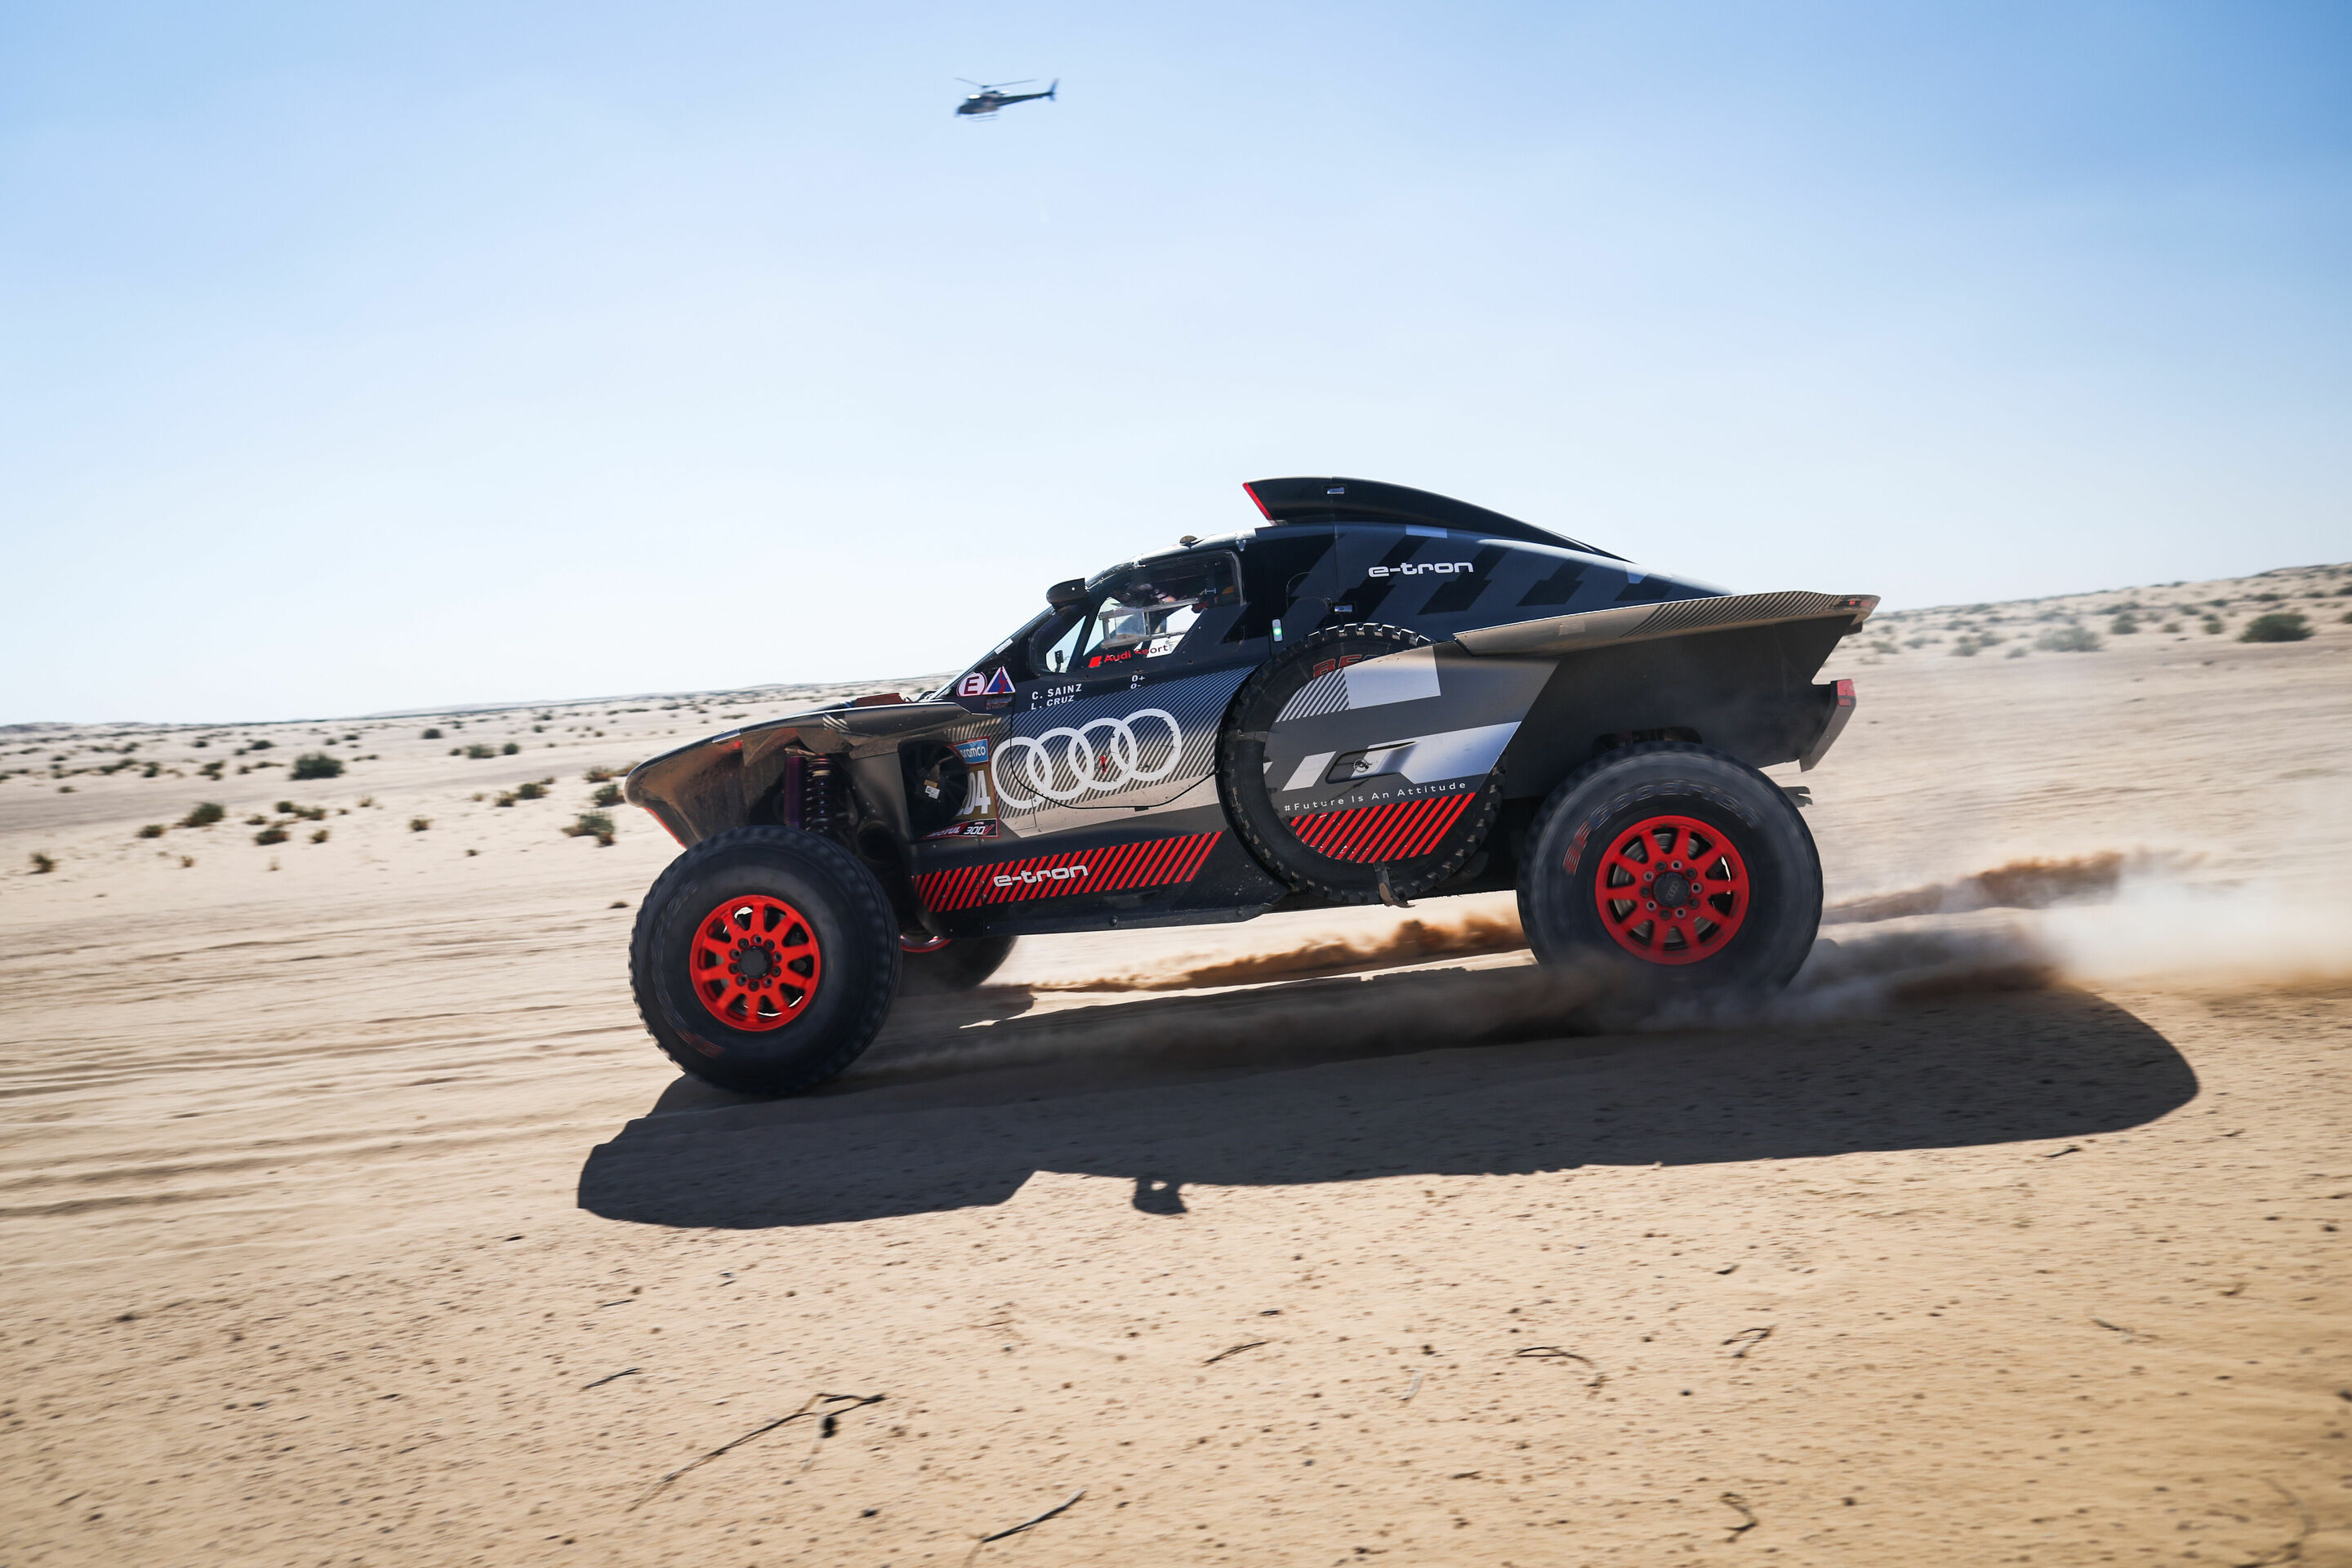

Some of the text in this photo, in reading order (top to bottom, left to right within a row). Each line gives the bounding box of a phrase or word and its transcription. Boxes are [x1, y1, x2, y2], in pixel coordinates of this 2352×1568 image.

[1368, 560, 1474, 577] e-tron
[1103, 644, 1169, 663] Audi Sport
[1312, 653, 1378, 679] BF
[964, 675, 980, 694] E
[1031, 684, 1082, 700] C. SAINZ
[1031, 694, 1075, 710] L. CRUZ
[960, 746, 986, 758] aramco
[956, 770, 991, 815] 04
[1283, 782, 1467, 813] #Future Is An Attitude
[964, 824, 995, 835] 300V
[992, 864, 1089, 888] e-tron
